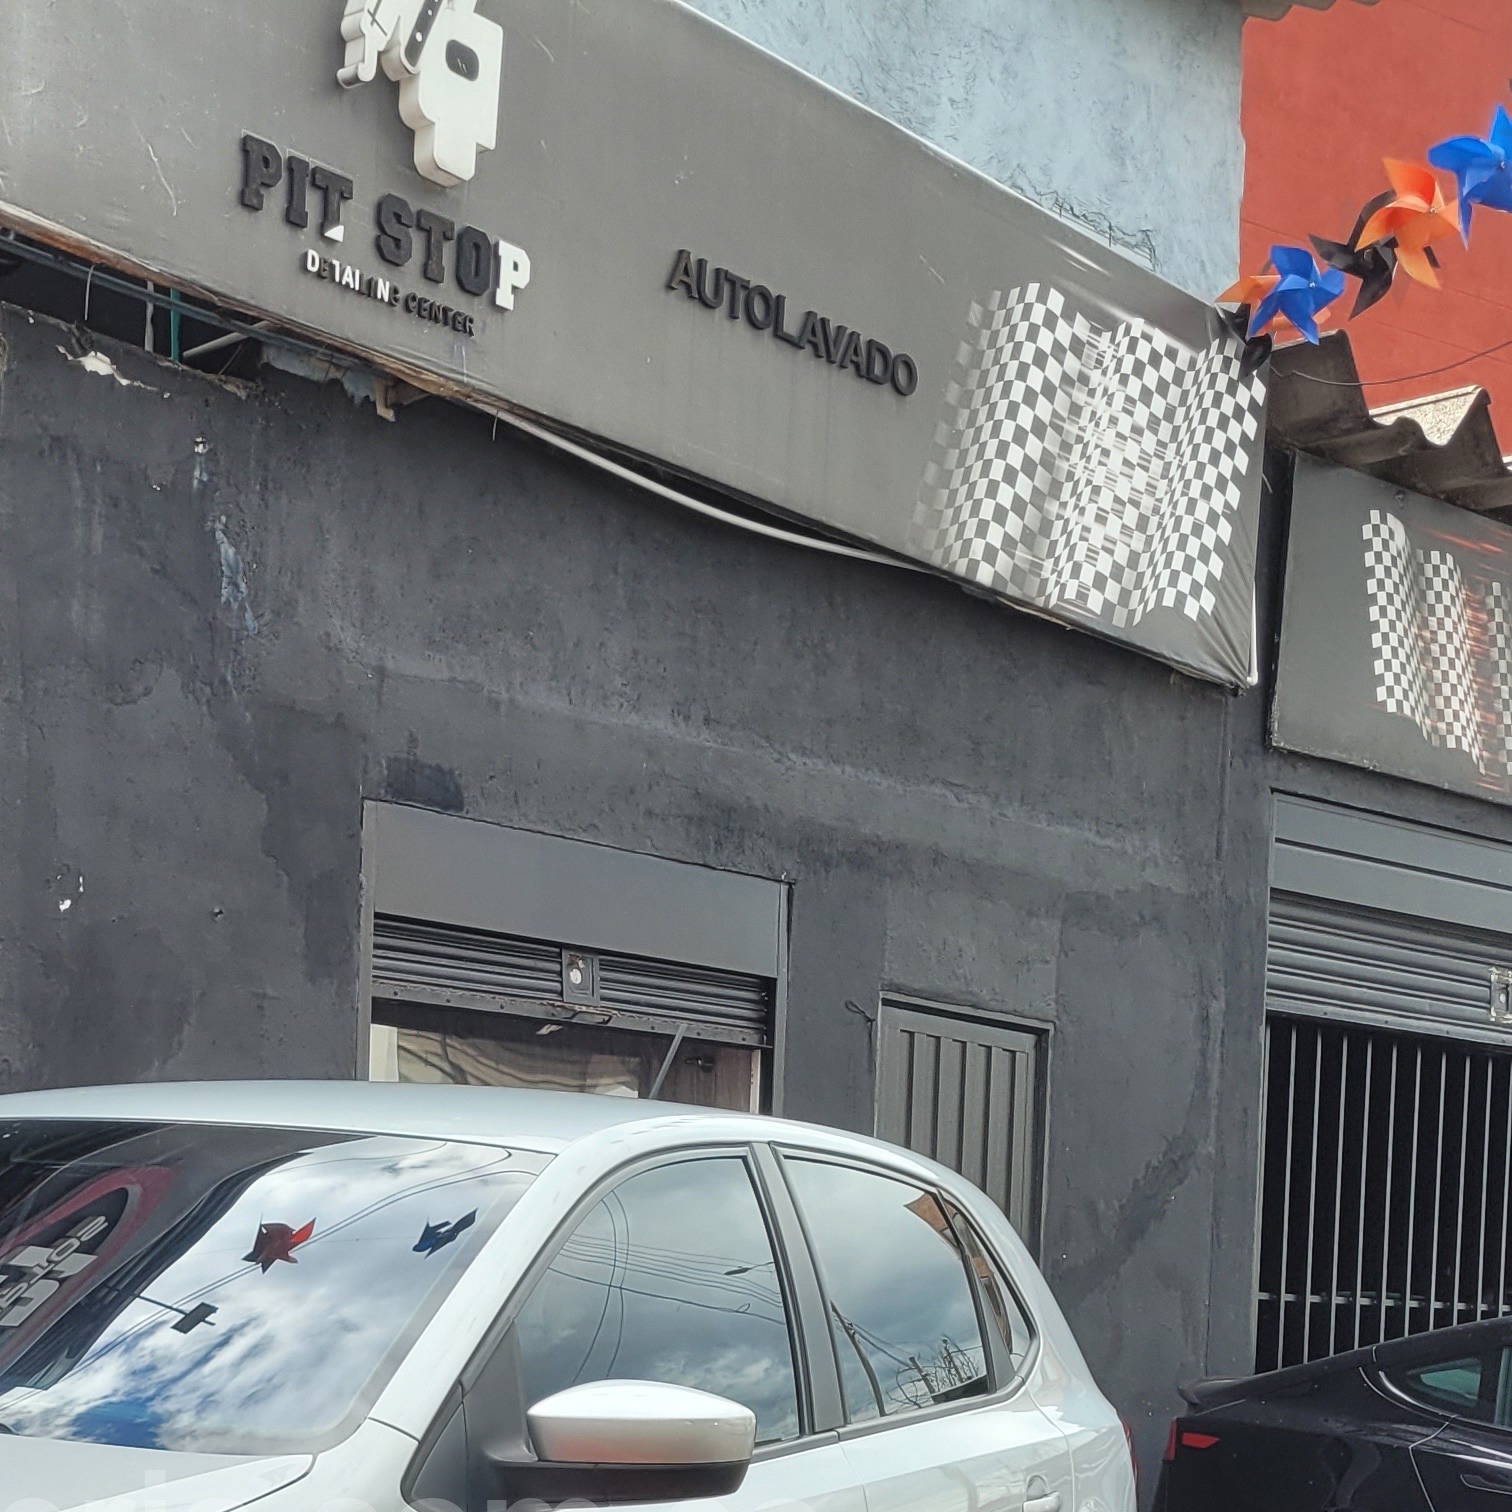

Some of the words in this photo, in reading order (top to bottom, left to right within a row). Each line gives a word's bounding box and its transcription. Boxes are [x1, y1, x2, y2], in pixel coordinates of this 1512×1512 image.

[240, 133, 354, 243] PIT
[374, 192, 531, 312] STOP
[404, 291, 475, 337] CENTER
[666, 248, 919, 397] AUTOLAVADO
